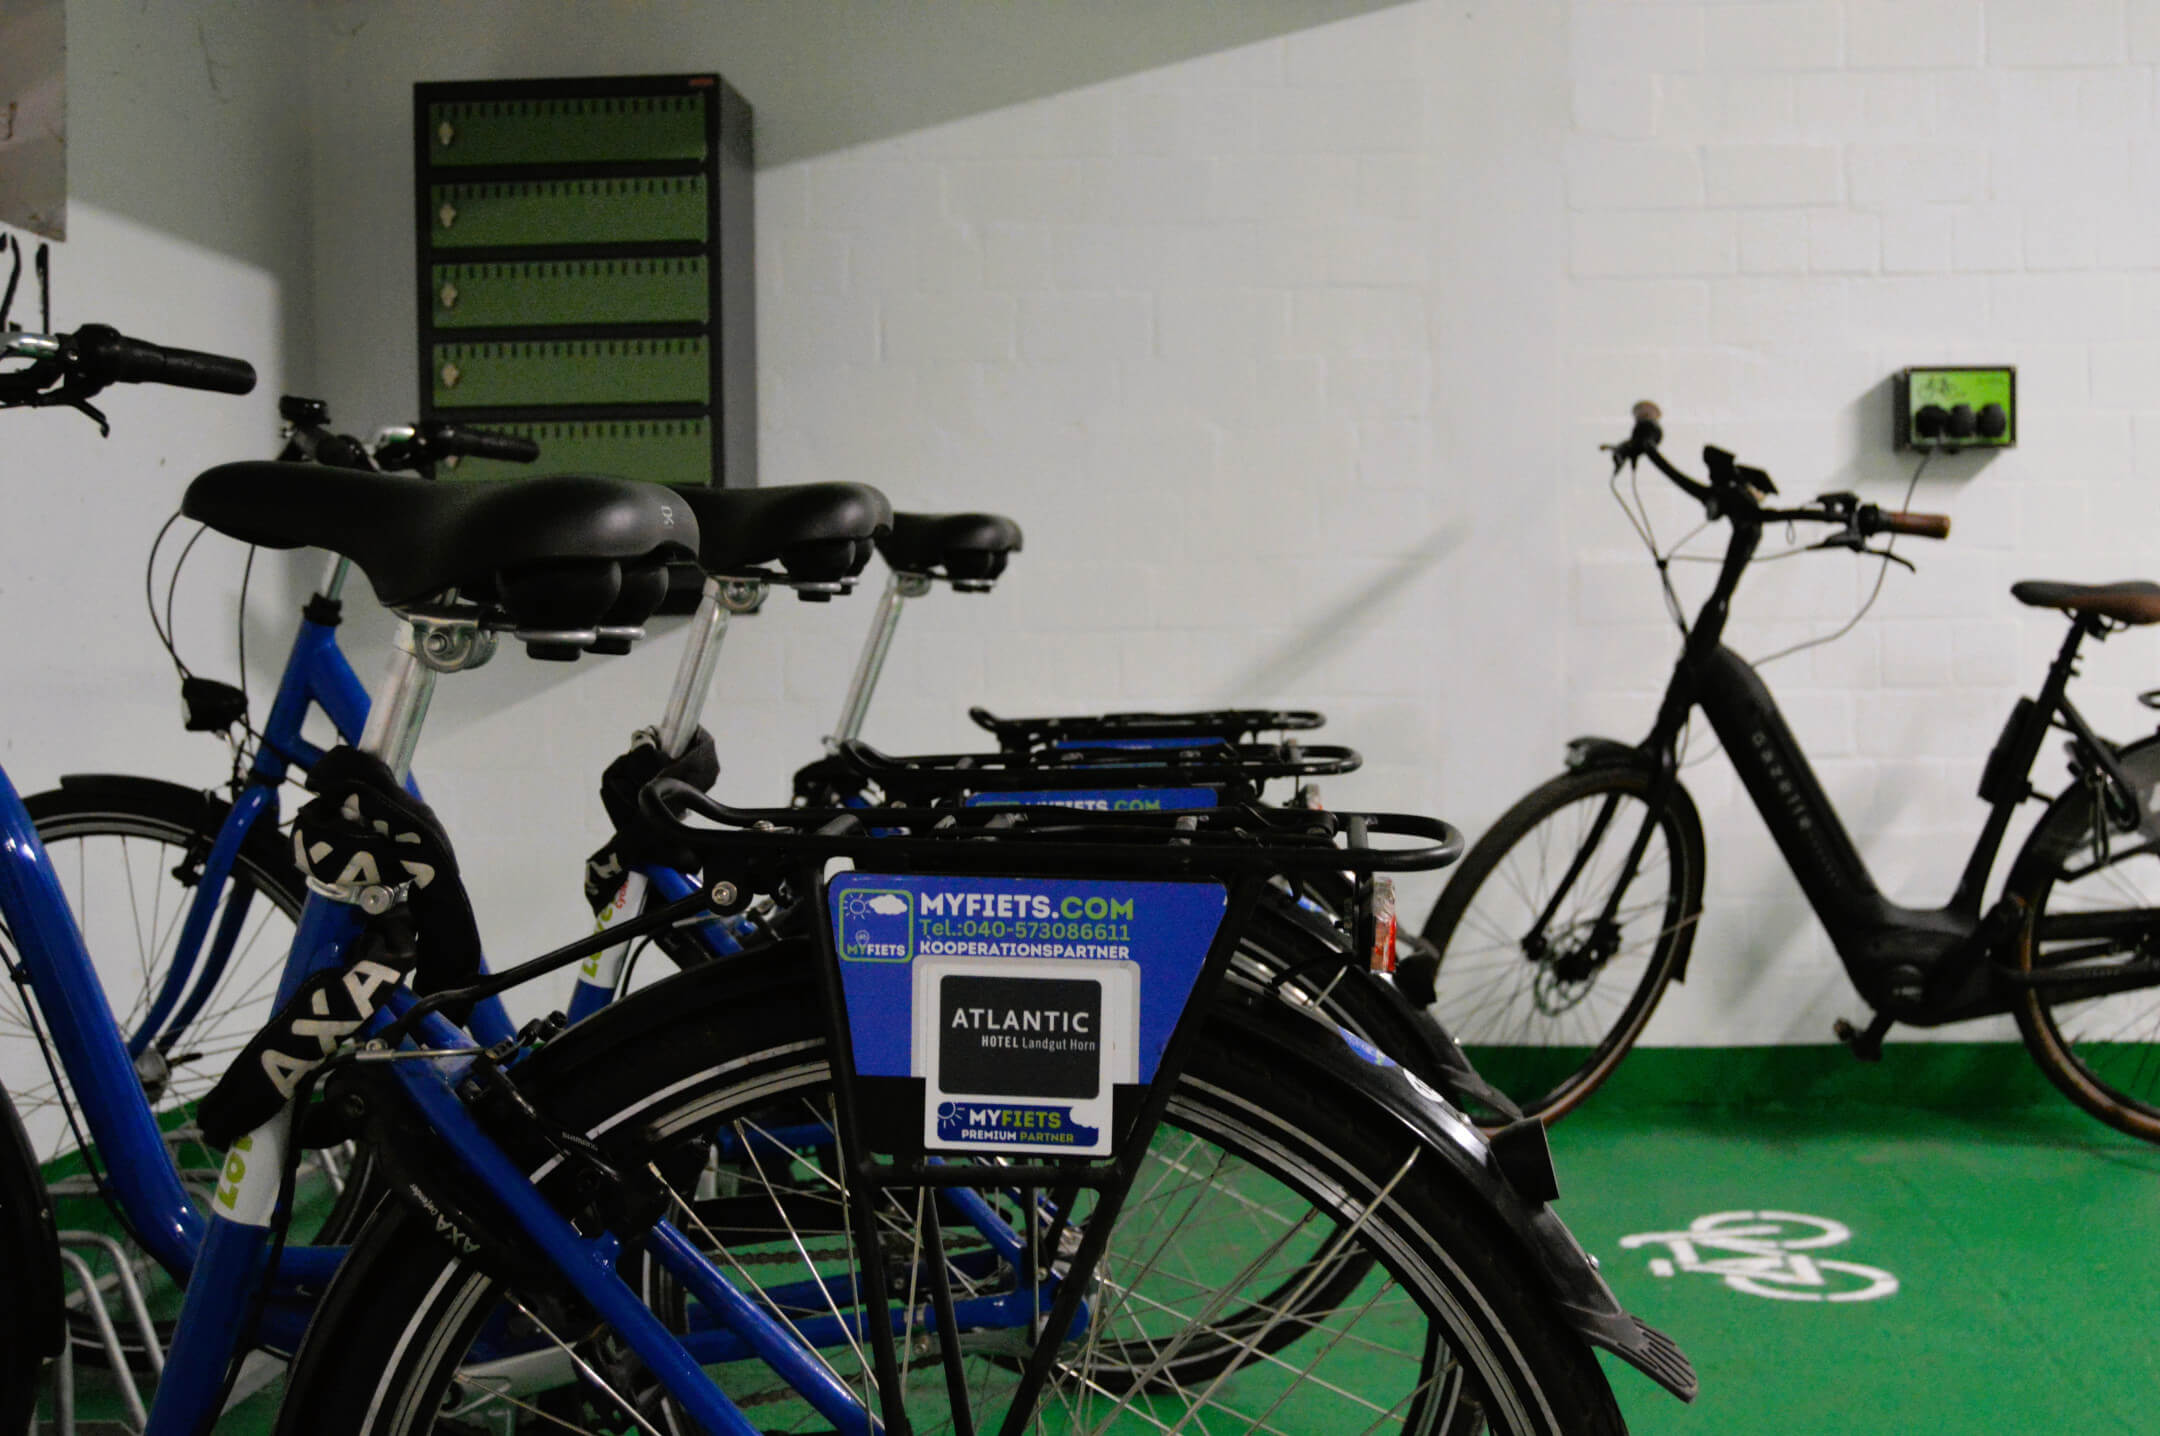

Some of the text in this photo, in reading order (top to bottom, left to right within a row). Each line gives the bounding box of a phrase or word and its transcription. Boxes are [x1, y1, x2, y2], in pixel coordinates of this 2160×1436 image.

[920, 892, 1134, 921] MYFIETS.COM
[919, 918, 1131, 941] Tel.:040-573086611
[847, 944, 906, 956] MYFIETS
[920, 941, 1130, 959] KOOPERATIONSPARTNER
[261, 960, 400, 1101] AXA
[951, 1007, 1089, 1033] ATLANTIC
[981, 1035, 1096, 1052] HOTEL Landgut Horn
[969, 1108, 1062, 1129] MYFIETS
[961, 1129, 1075, 1143] PREMIUM PARTNER
[435, 1213, 481, 1253] AXA
